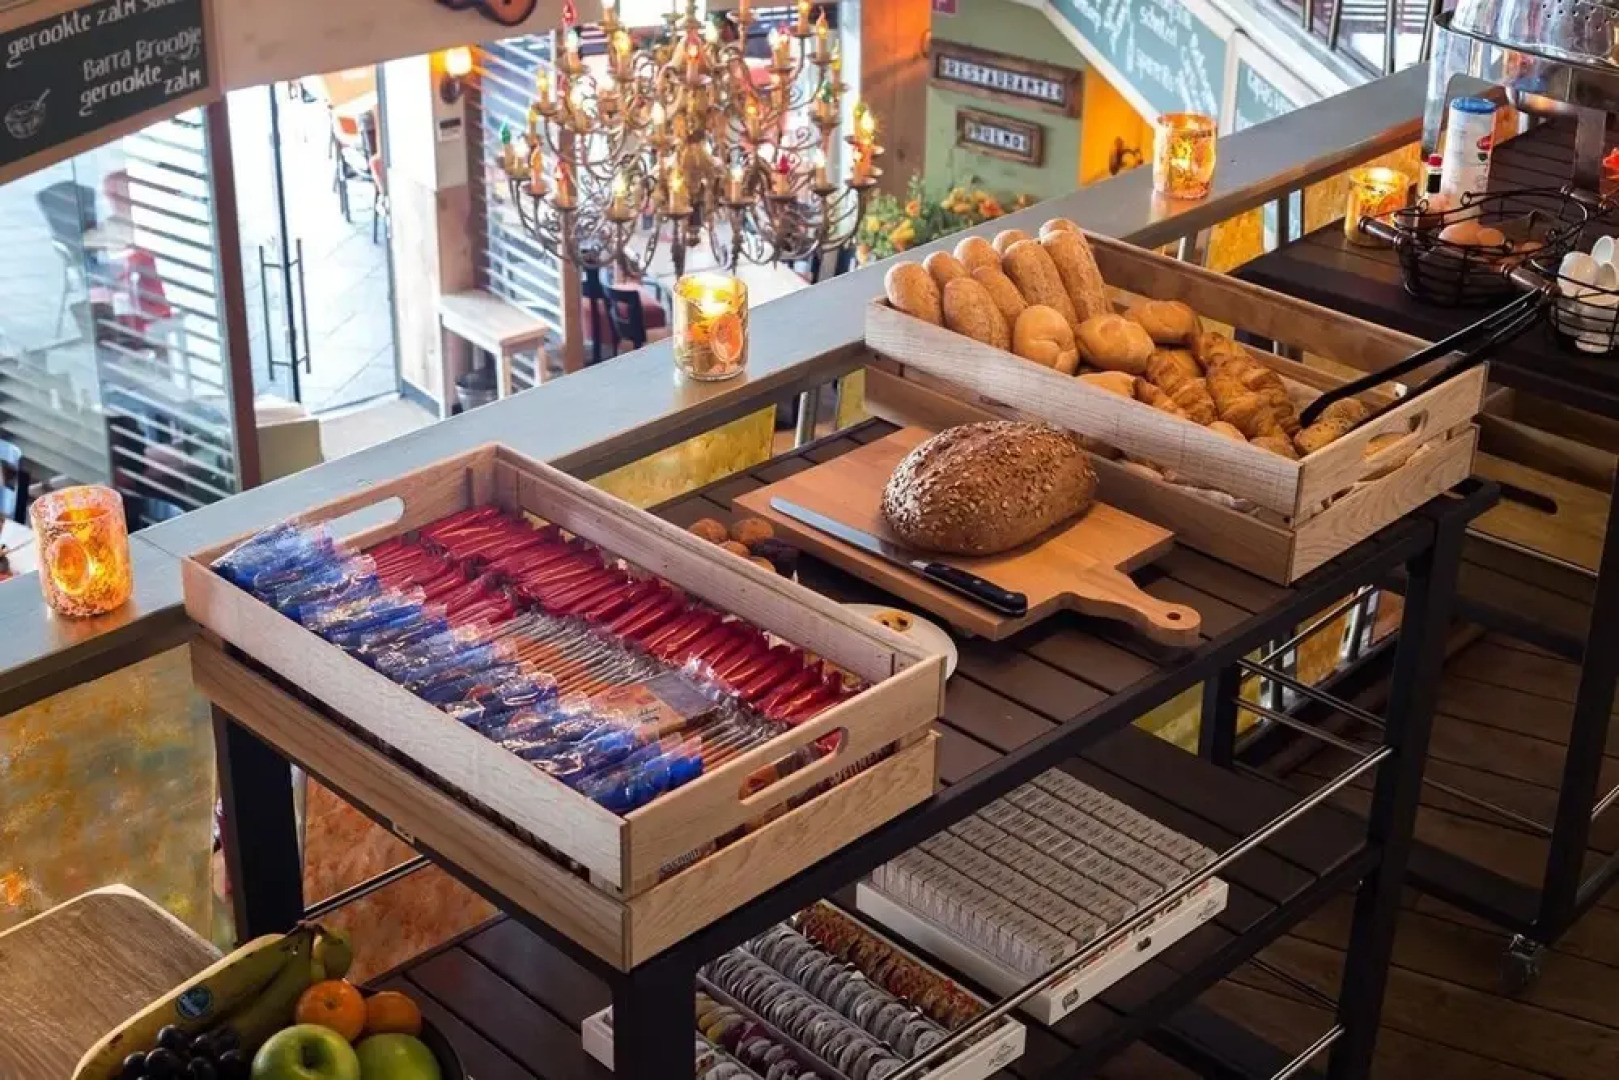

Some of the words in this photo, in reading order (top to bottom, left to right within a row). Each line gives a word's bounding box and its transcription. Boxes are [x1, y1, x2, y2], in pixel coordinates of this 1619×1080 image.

[6, 10, 91, 69] gerookte
[83, 49, 131, 81] Barra
[79, 64, 162, 117] gerookte
